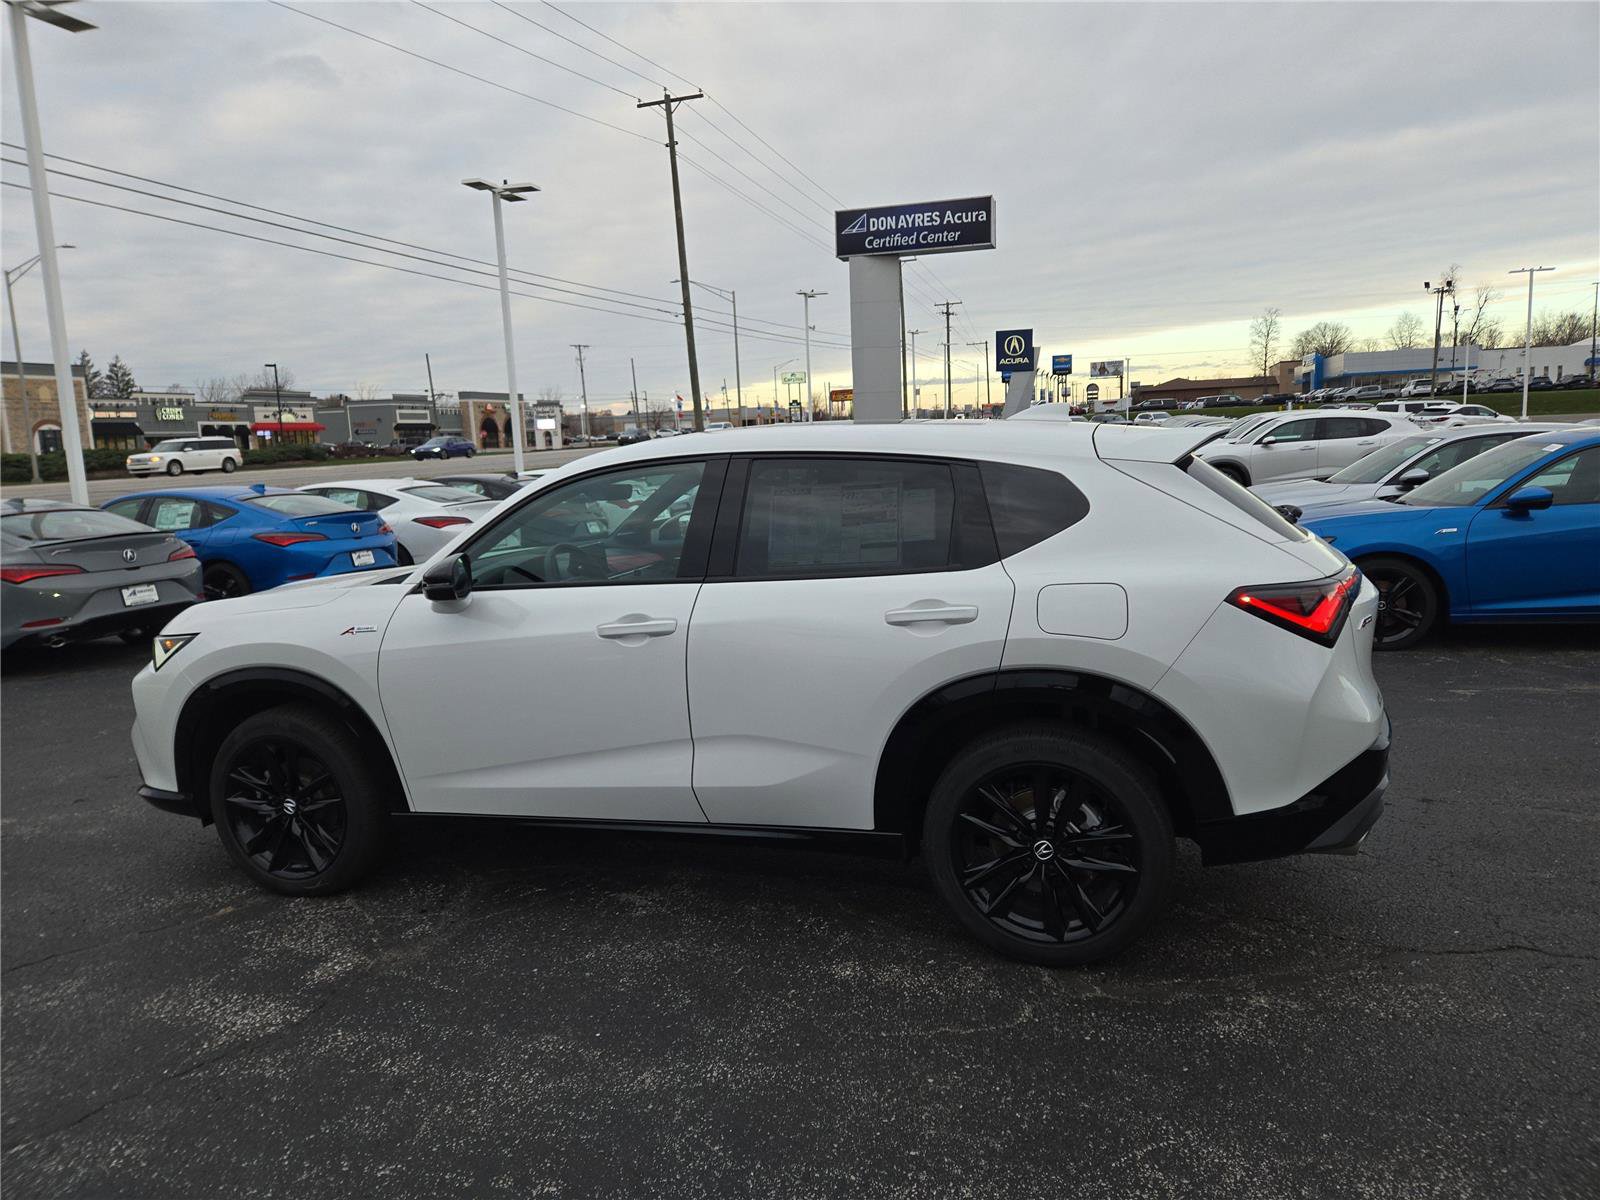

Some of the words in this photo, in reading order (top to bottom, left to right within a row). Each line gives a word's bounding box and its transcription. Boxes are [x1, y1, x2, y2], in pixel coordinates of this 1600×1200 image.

[869, 216, 896, 232] DON
[899, 211, 941, 228] AYRES
[943, 210, 987, 225] Acura
[865, 232, 917, 249] Certified
[919, 230, 961, 244] Center
[999, 356, 1030, 365] ACURA
